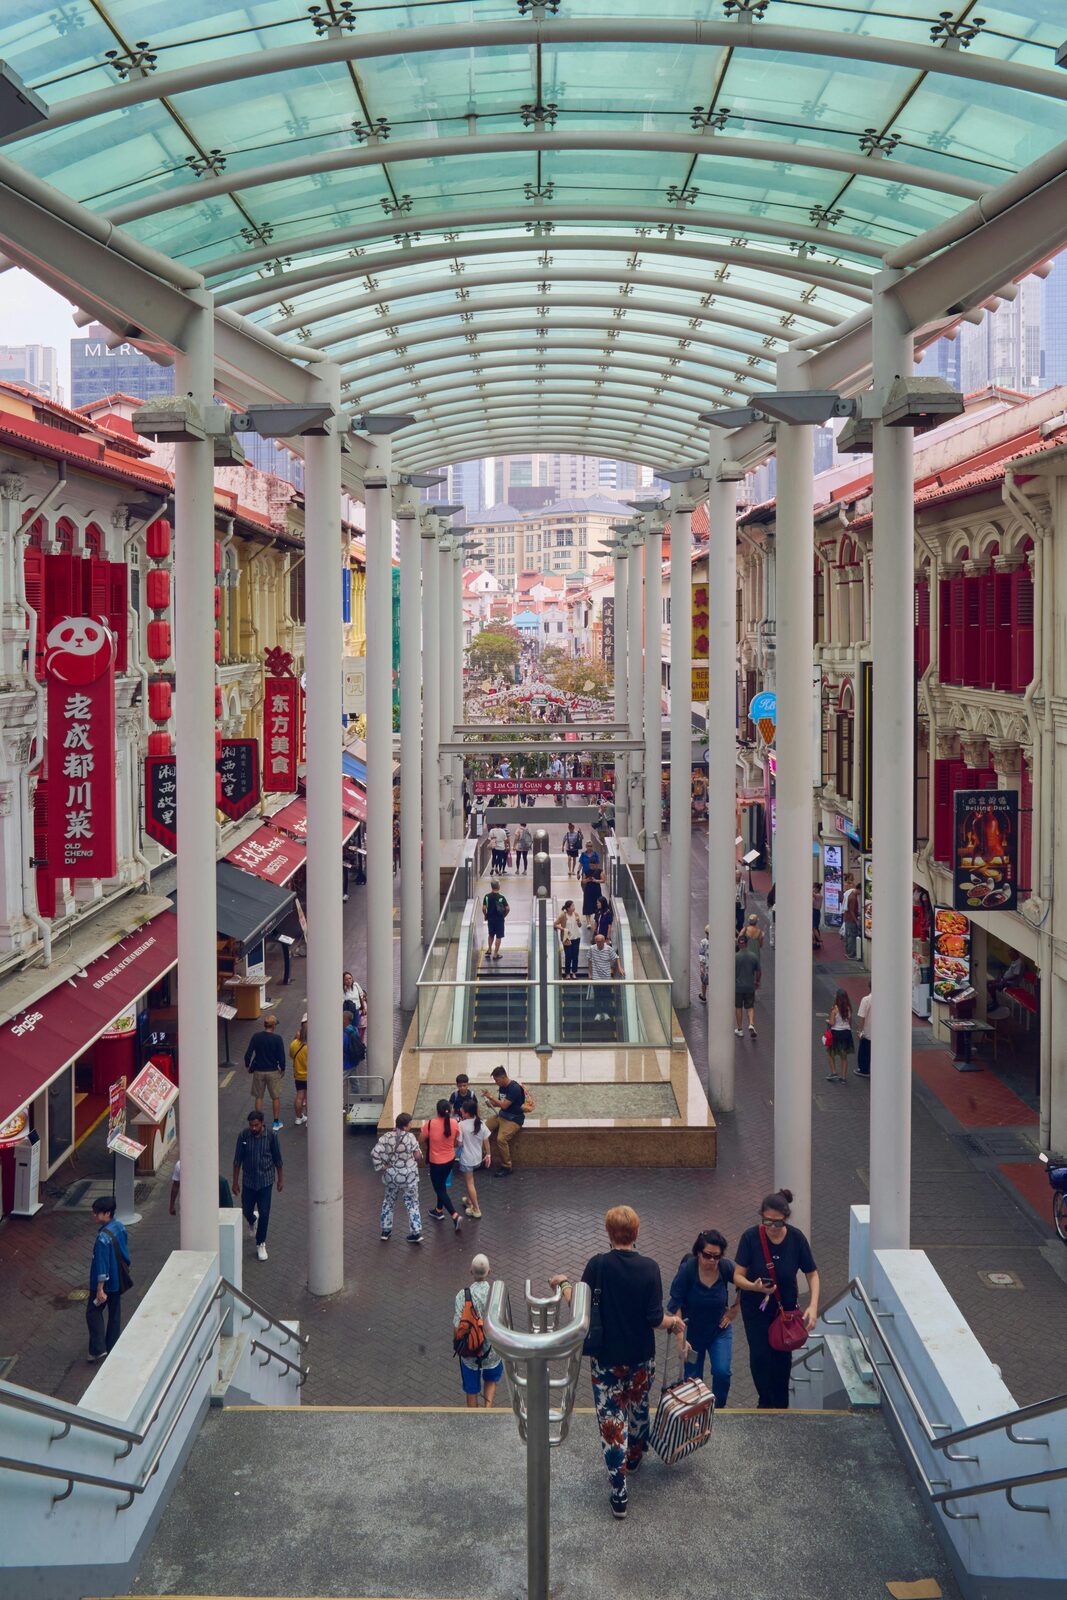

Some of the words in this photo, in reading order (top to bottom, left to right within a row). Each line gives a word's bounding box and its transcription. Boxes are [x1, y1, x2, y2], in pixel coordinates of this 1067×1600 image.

[63, 692, 95, 839] 老成都川菜
[271, 694, 290, 774] 东方美食
[158, 765, 176, 824] 湘西故里
[221, 746, 237, 797] 湘西故里
